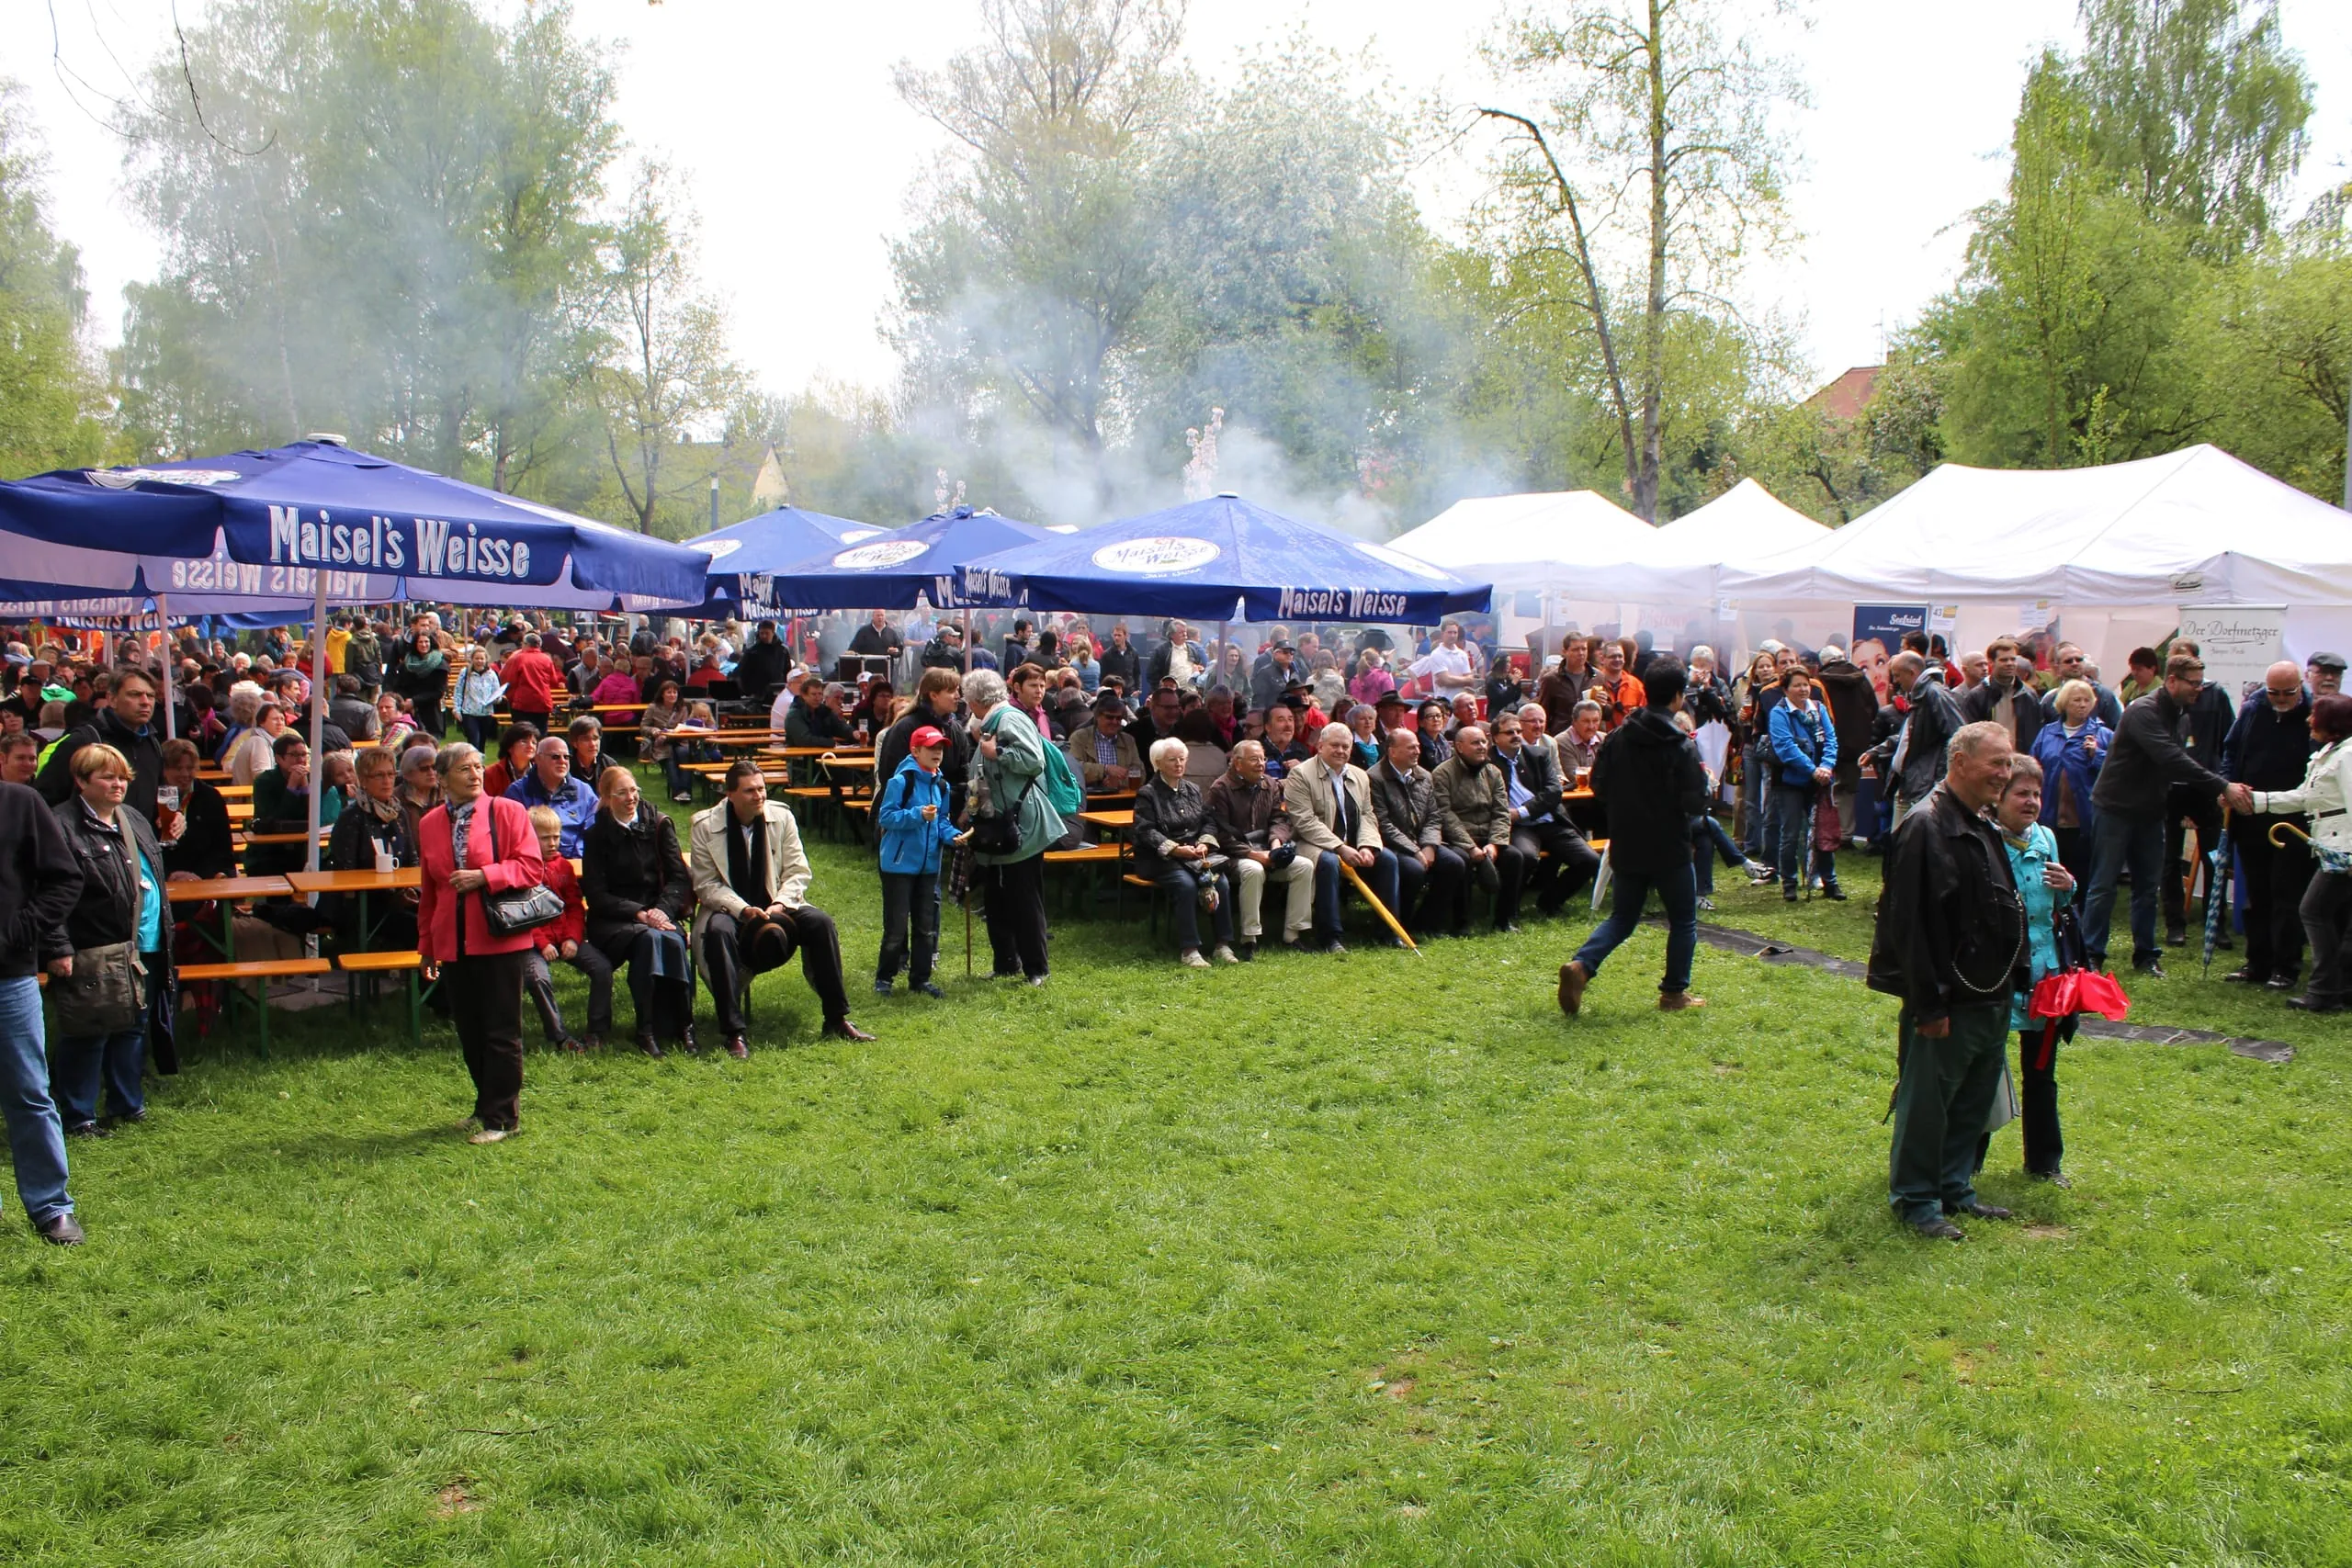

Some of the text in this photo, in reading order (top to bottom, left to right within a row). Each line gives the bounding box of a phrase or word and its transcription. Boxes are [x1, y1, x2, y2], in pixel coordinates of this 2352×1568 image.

[267, 505, 530, 579] Maisel's Weisse
[1277, 585, 1408, 619] Maisel's Weisse
[1889, 614, 1922, 626] Seefried
[2183, 620, 2278, 641] Der Dorfmetzger
